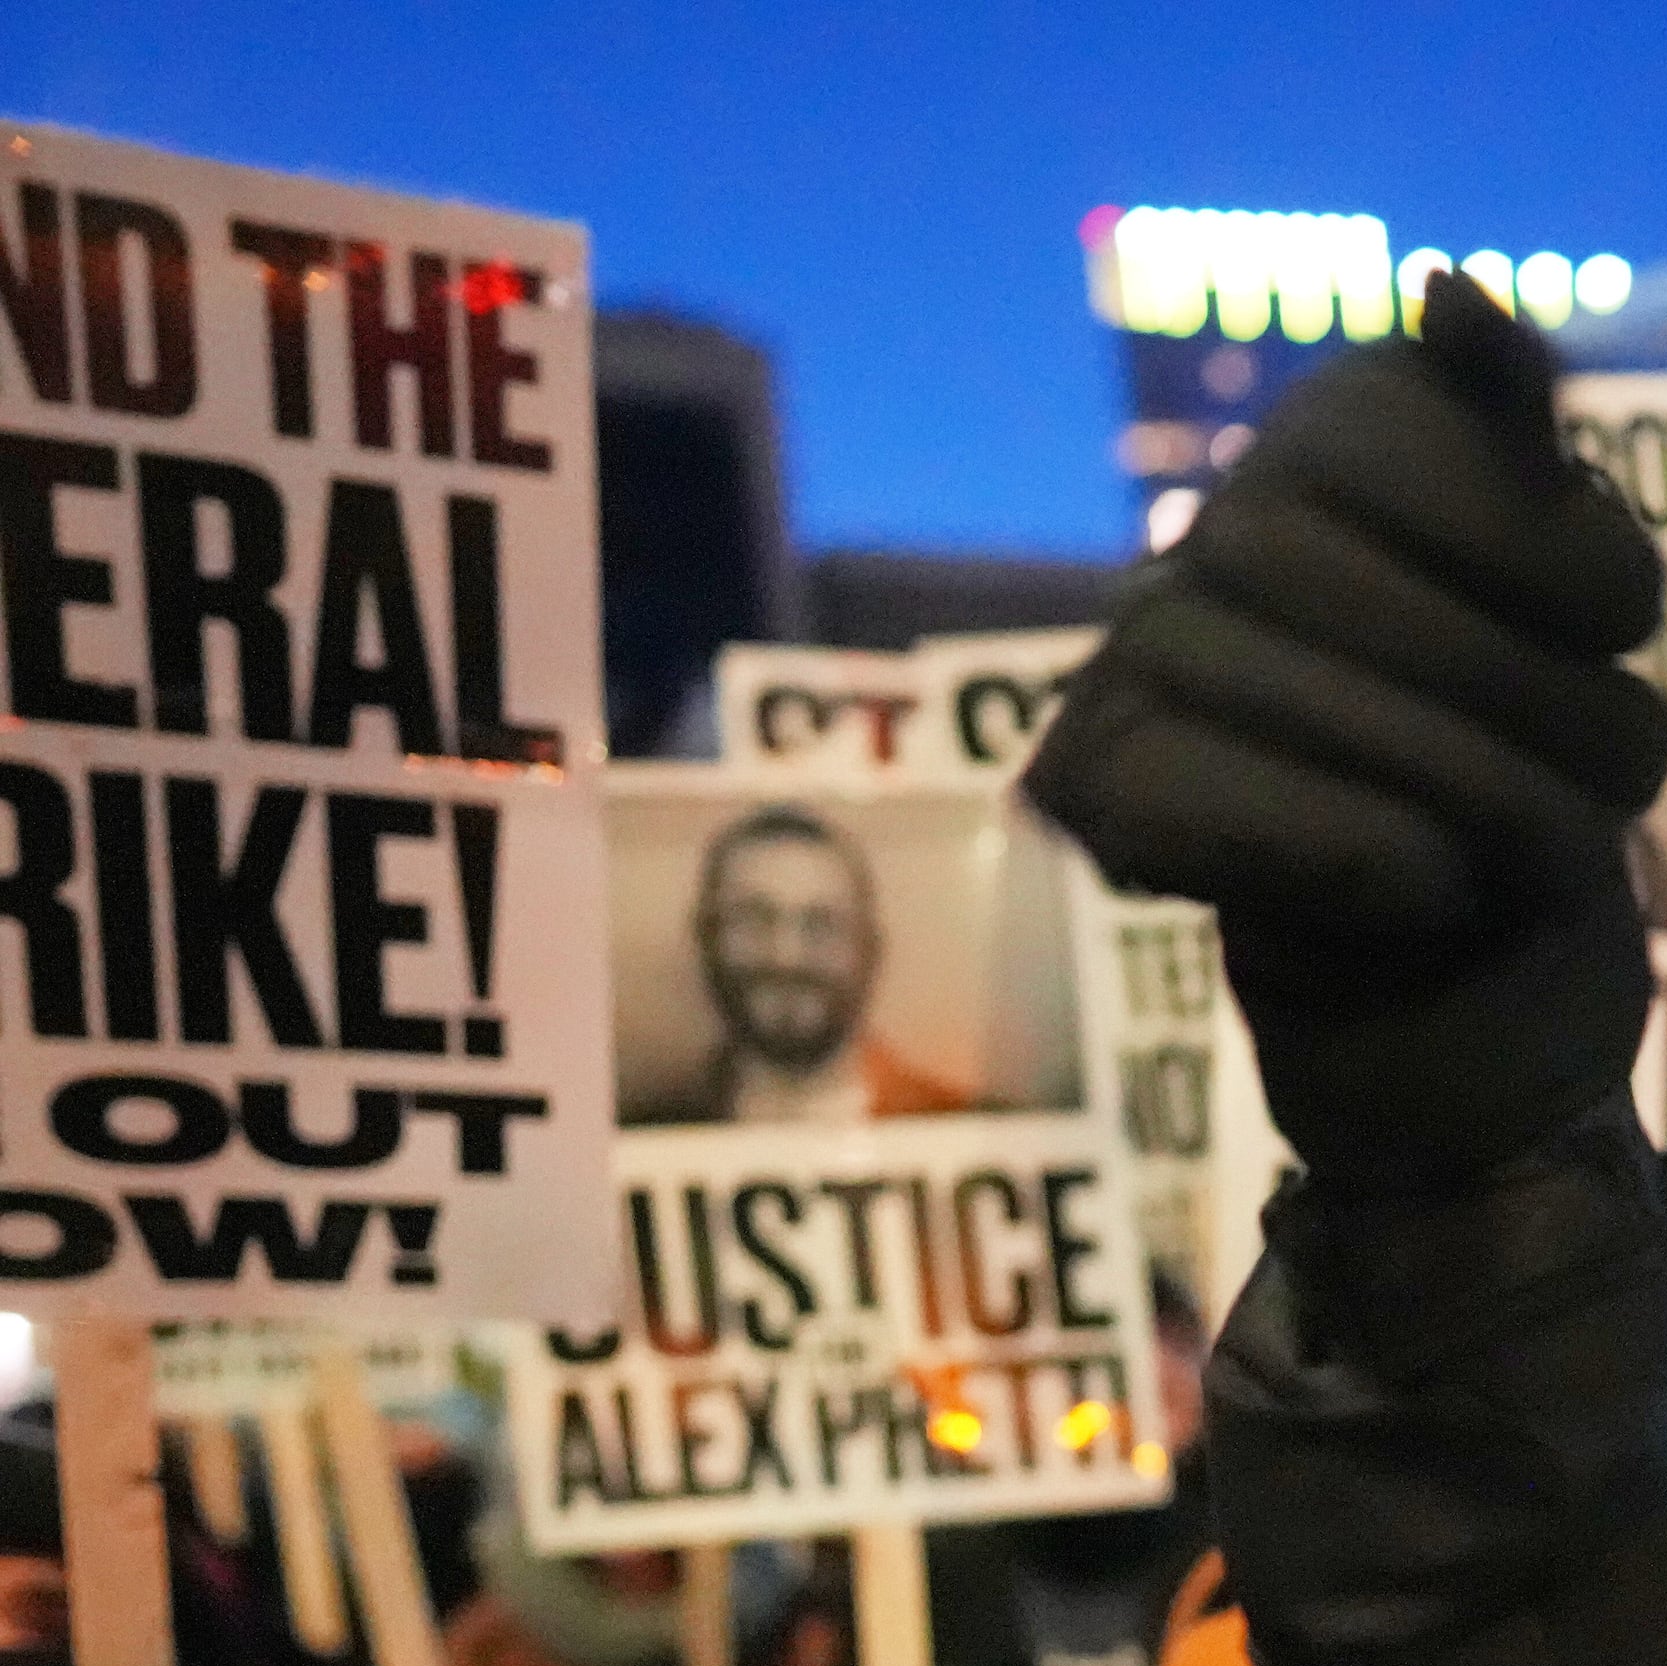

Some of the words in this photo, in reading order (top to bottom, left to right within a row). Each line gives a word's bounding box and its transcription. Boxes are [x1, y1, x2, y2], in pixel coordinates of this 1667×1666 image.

[230, 212, 552, 474] THE
[0, 432, 563, 765] ERAL
[0, 757, 505, 1058] RIKE!
[48, 1073, 550, 1175] OUT
[0, 1190, 440, 1287] OW!
[548, 1168, 1115, 1365] USTICE
[557, 1378, 794, 1510] ALEX
